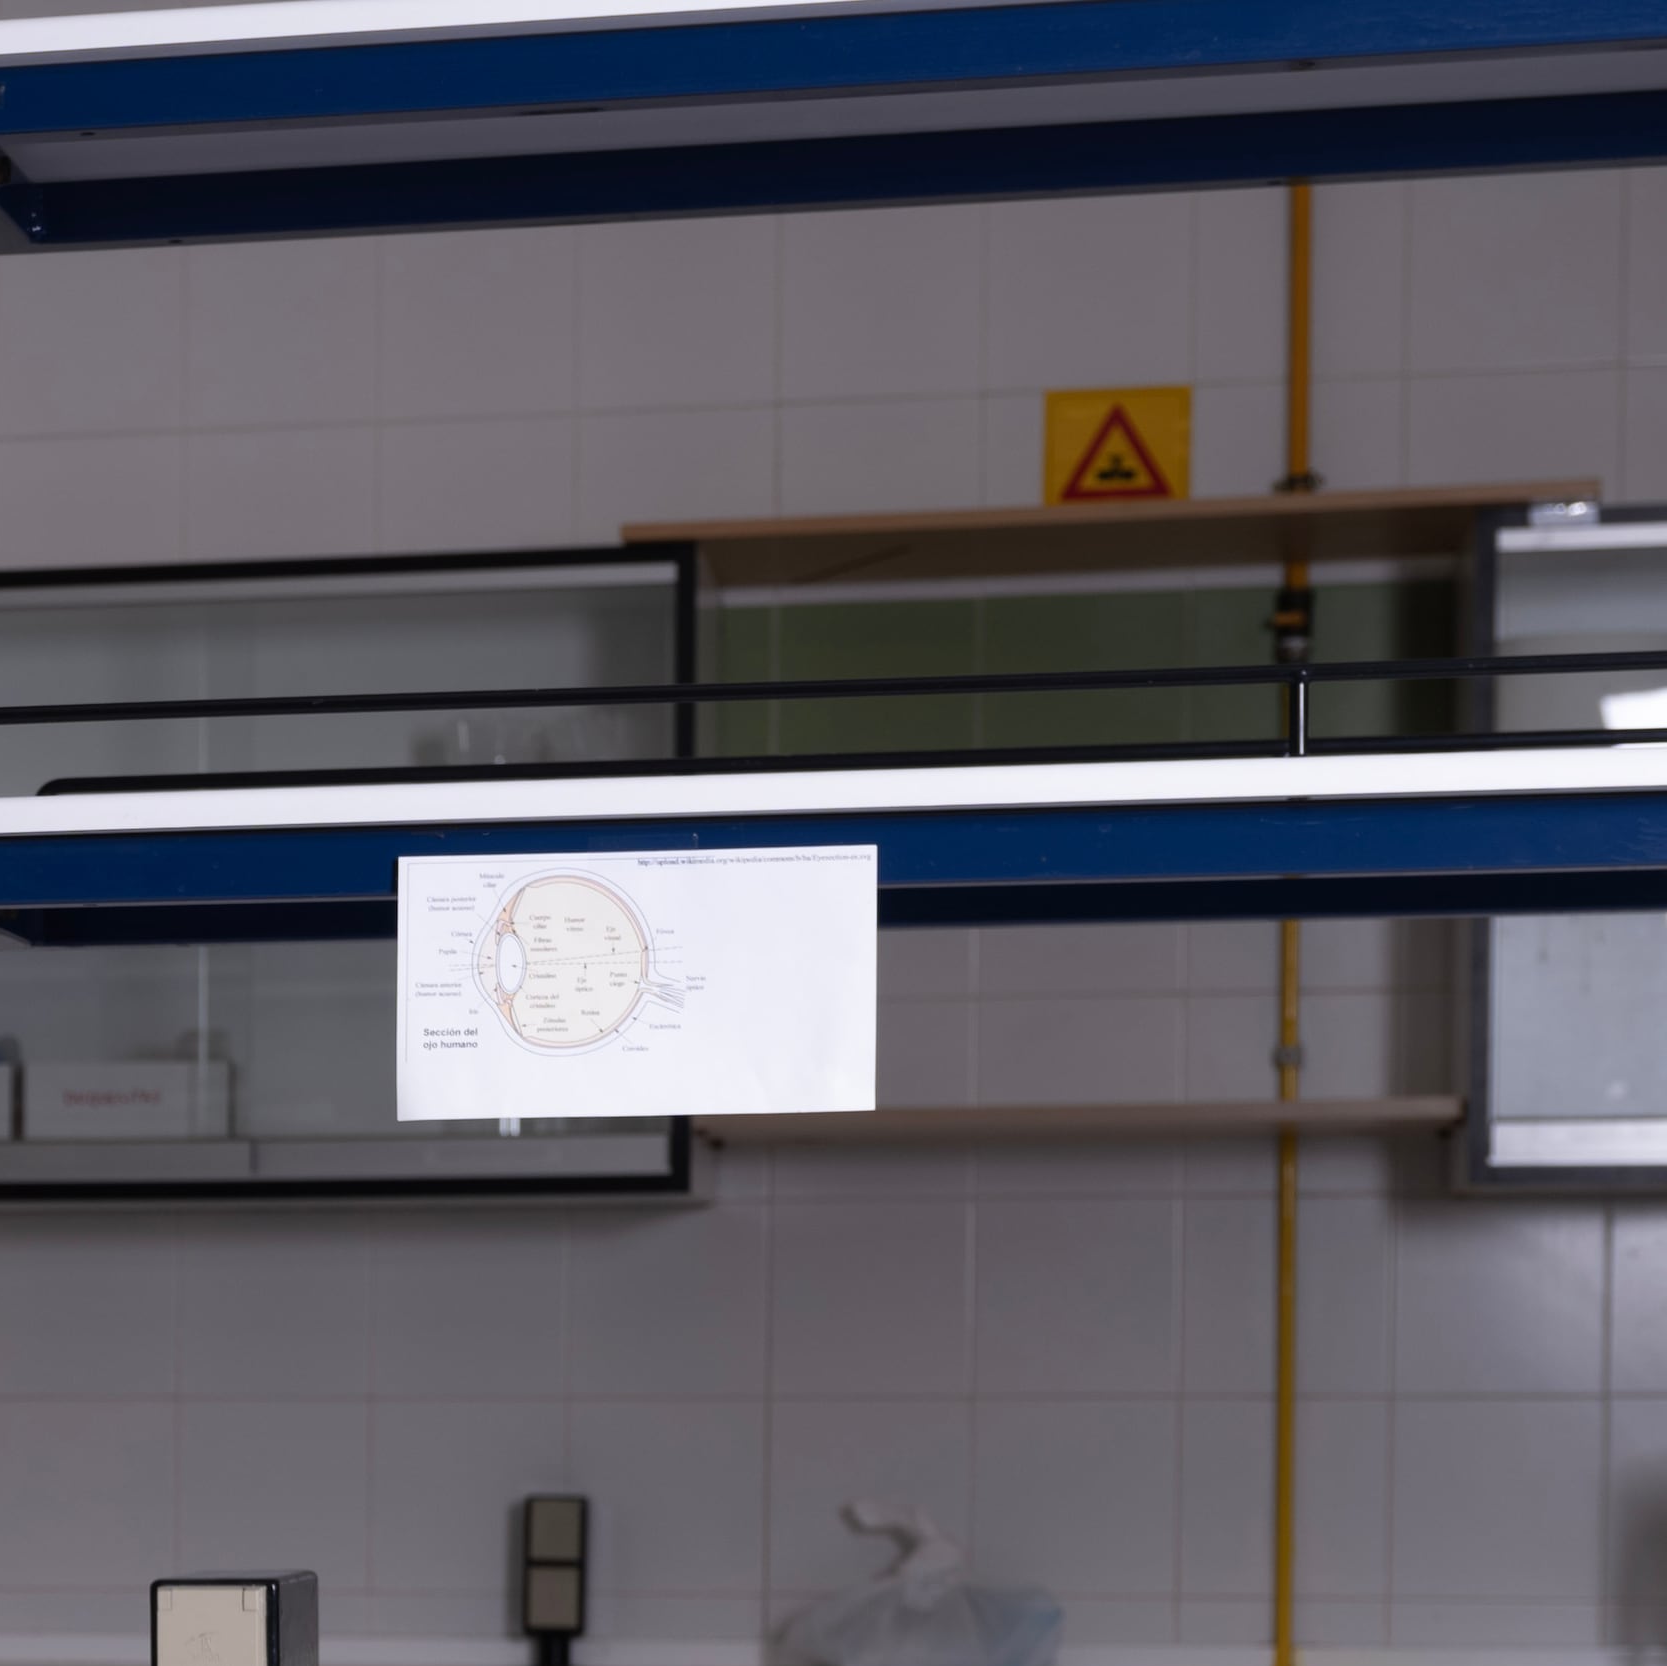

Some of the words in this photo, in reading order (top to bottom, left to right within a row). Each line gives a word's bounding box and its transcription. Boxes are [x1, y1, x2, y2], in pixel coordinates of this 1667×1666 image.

[423, 1027, 461, 1037] Sección
[463, 1026, 478, 1037] del
[422, 1040, 438, 1051] ojo
[441, 1039, 478, 1049] humano
